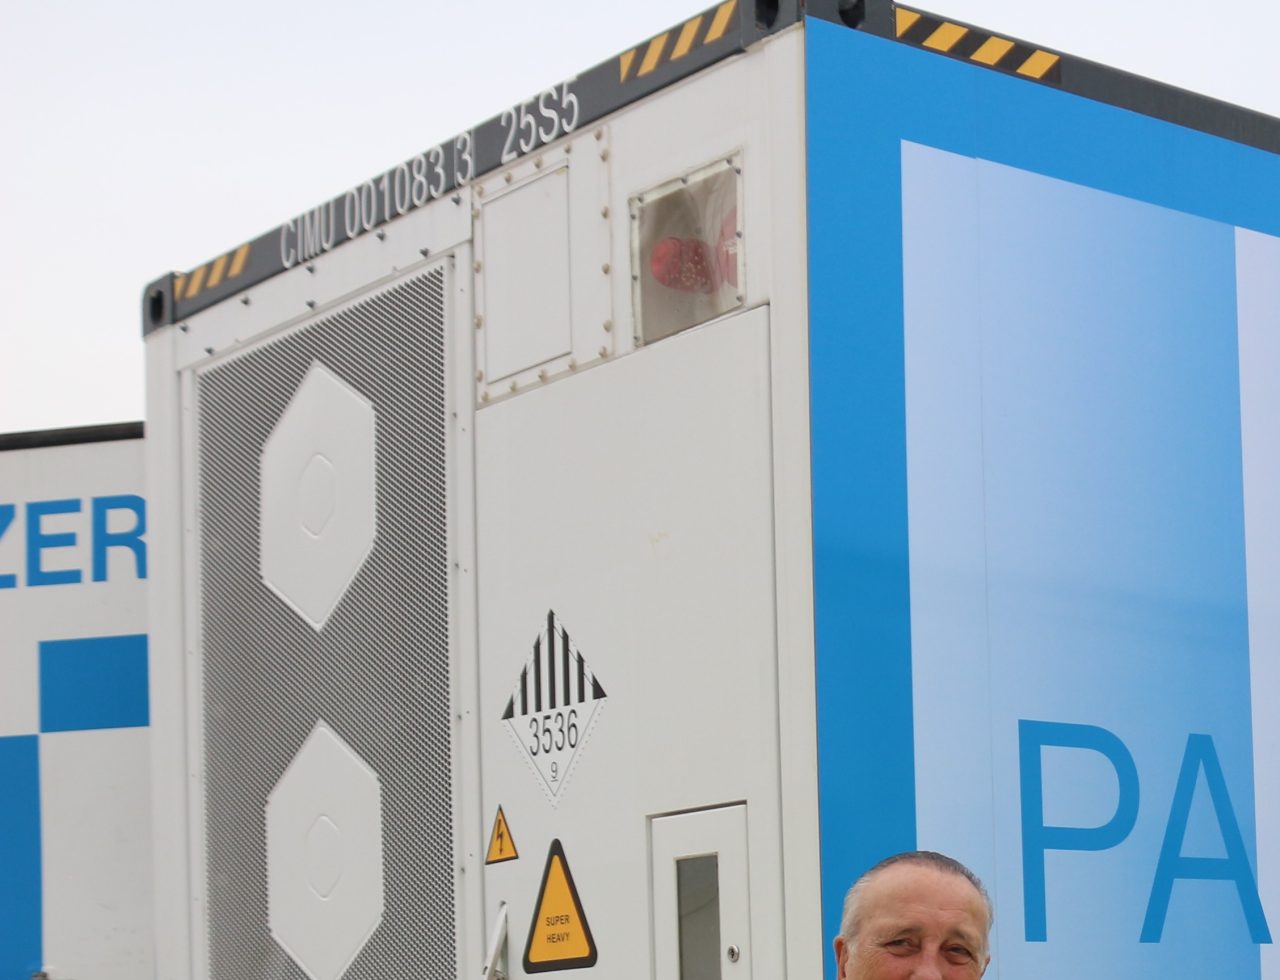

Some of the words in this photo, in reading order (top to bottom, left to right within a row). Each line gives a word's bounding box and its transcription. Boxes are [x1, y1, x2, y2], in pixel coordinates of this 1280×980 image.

[280, 199, 335, 269] CIMU
[344, 143, 446, 239] 001083
[501, 77, 579, 164] 25S5
[529, 709, 579, 757] 3536
[550, 761, 559, 781] 9
[546, 914, 570, 926] SUPER
[546, 932, 570, 944] HEAVY
